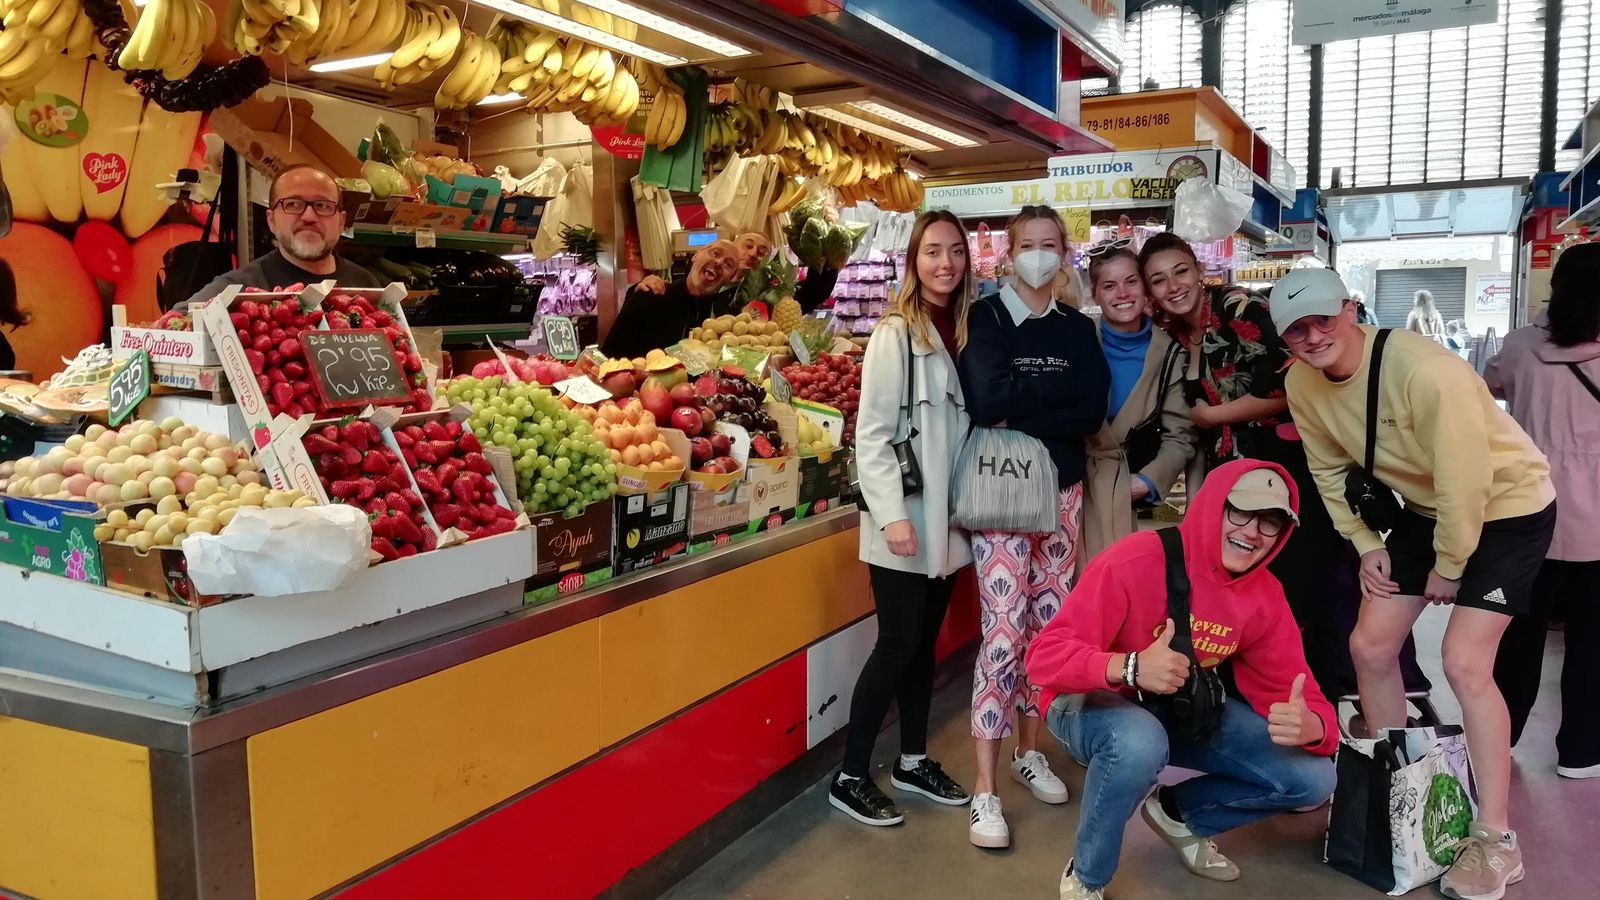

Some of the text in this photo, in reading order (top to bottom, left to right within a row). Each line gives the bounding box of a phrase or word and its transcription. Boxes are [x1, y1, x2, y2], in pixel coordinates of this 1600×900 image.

[1087, 113, 1170, 132] 79-81/84-86/186
[609, 136, 631, 147] Pink
[89, 156, 119, 174] Pink
[94, 169, 123, 184] Lady
[931, 186, 1004, 198] CONDIMENTOS
[1010, 178, 1132, 205] EL RELO
[1075, 219, 1085, 239] 6
[121, 330, 193, 358] Fres-Quintero
[308, 335, 326, 345] DE
[227, 345, 256, 409] FRESONITAS
[978, 456, 1032, 480] HAY
[548, 528, 593, 557] Ayah
[32, 555, 51, 569] AGRO
